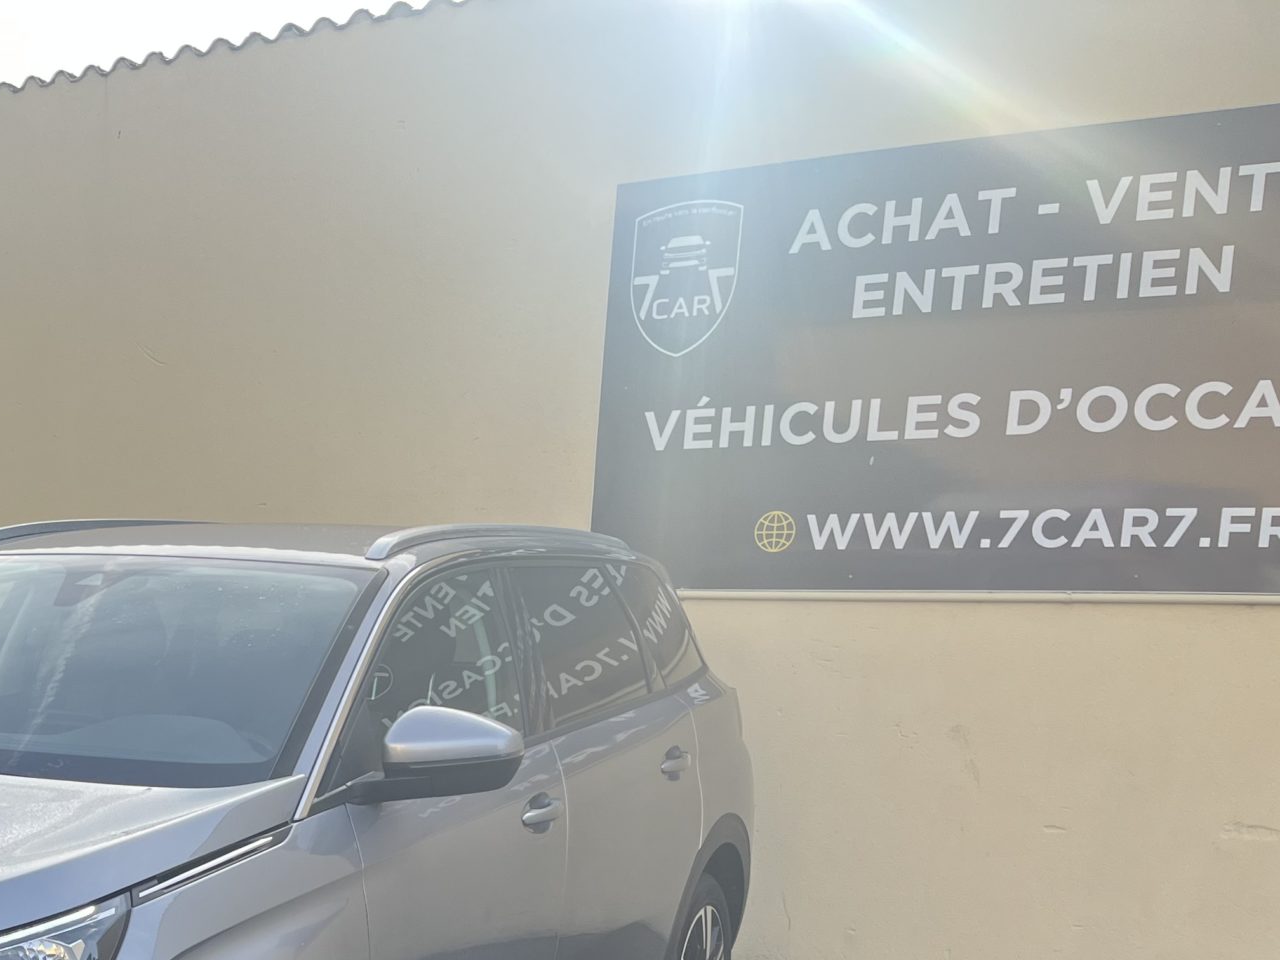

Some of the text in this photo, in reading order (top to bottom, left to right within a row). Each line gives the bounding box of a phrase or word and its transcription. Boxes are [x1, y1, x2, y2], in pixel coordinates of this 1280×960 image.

[789, 187, 1016, 254] ACHAT
[851, 245, 1235, 319] ENTRETIEN
[644, 392, 981, 451] VÉHICULES
